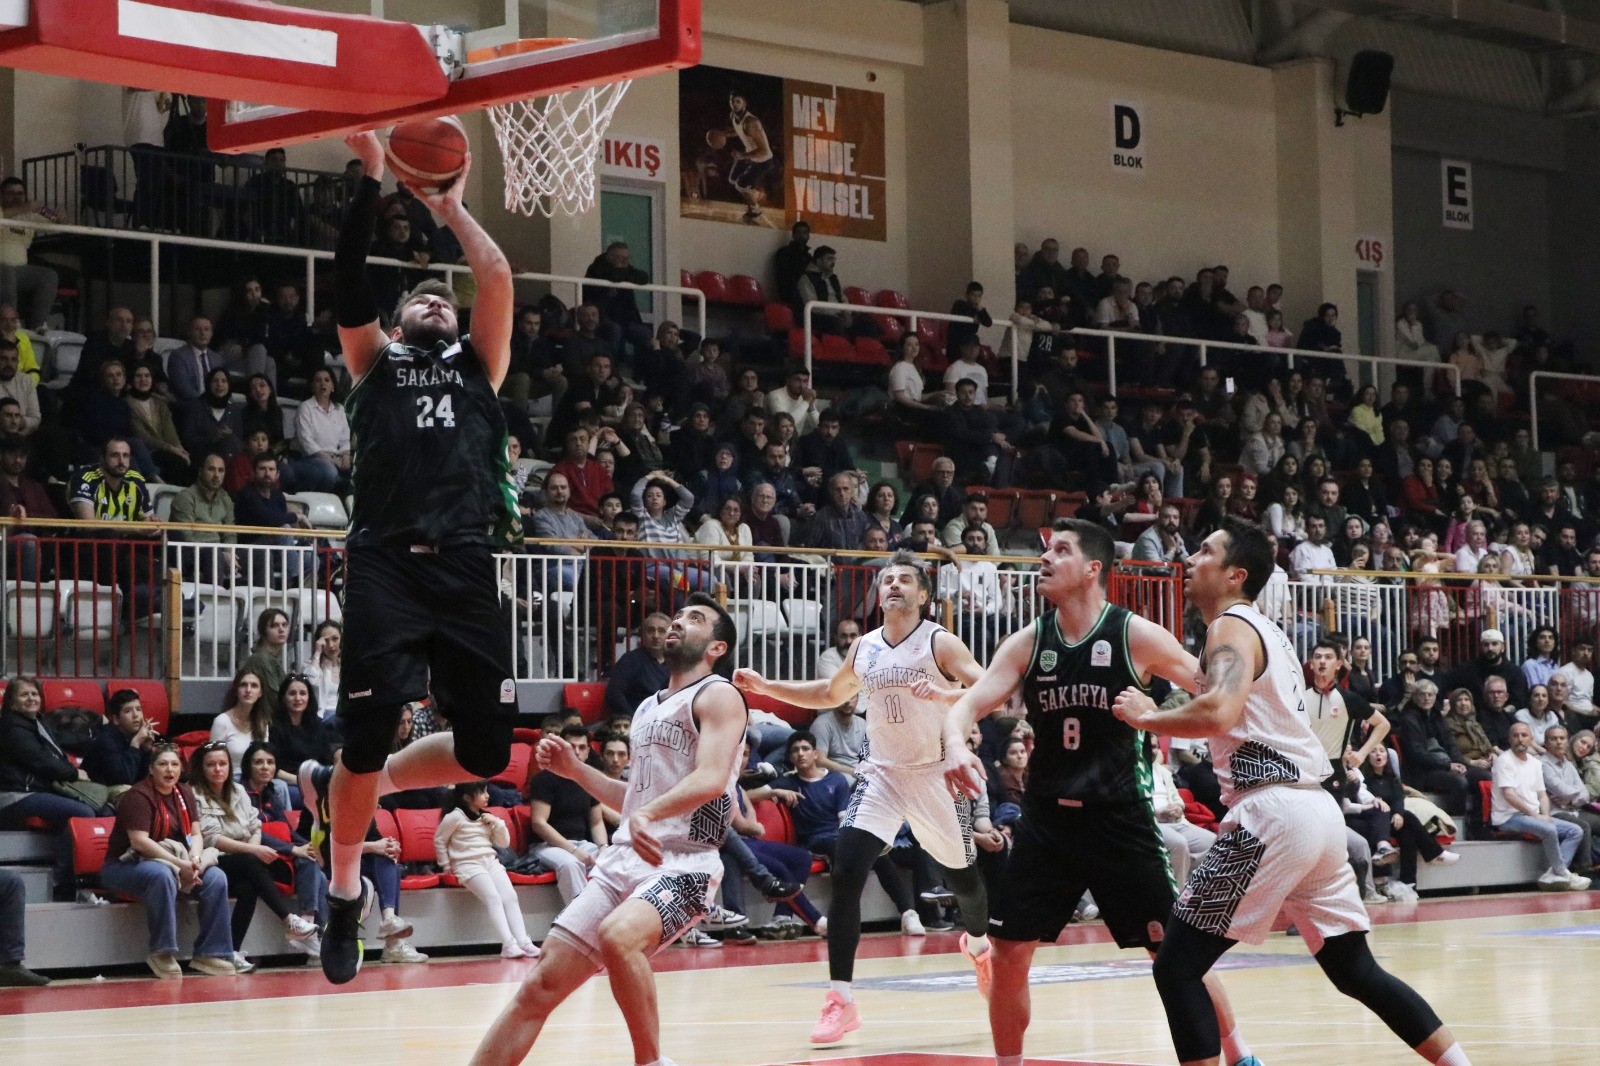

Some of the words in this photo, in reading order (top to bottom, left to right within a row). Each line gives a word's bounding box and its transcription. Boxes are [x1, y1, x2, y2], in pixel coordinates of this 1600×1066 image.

[792, 93, 837, 133] MEV
[1114, 104, 1141, 149] D
[598, 138, 661, 177] IKIŞ
[1113, 153, 1143, 169] BLOK
[792, 174, 875, 220] YÜKSEL
[1446, 165, 1468, 207] E
[1445, 209, 1470, 223] BLOK
[416, 394, 456, 428] 24
[885, 694, 905, 724] 11
[1038, 684, 1109, 712] SAKARYA
[1063, 717, 1080, 751] 8
